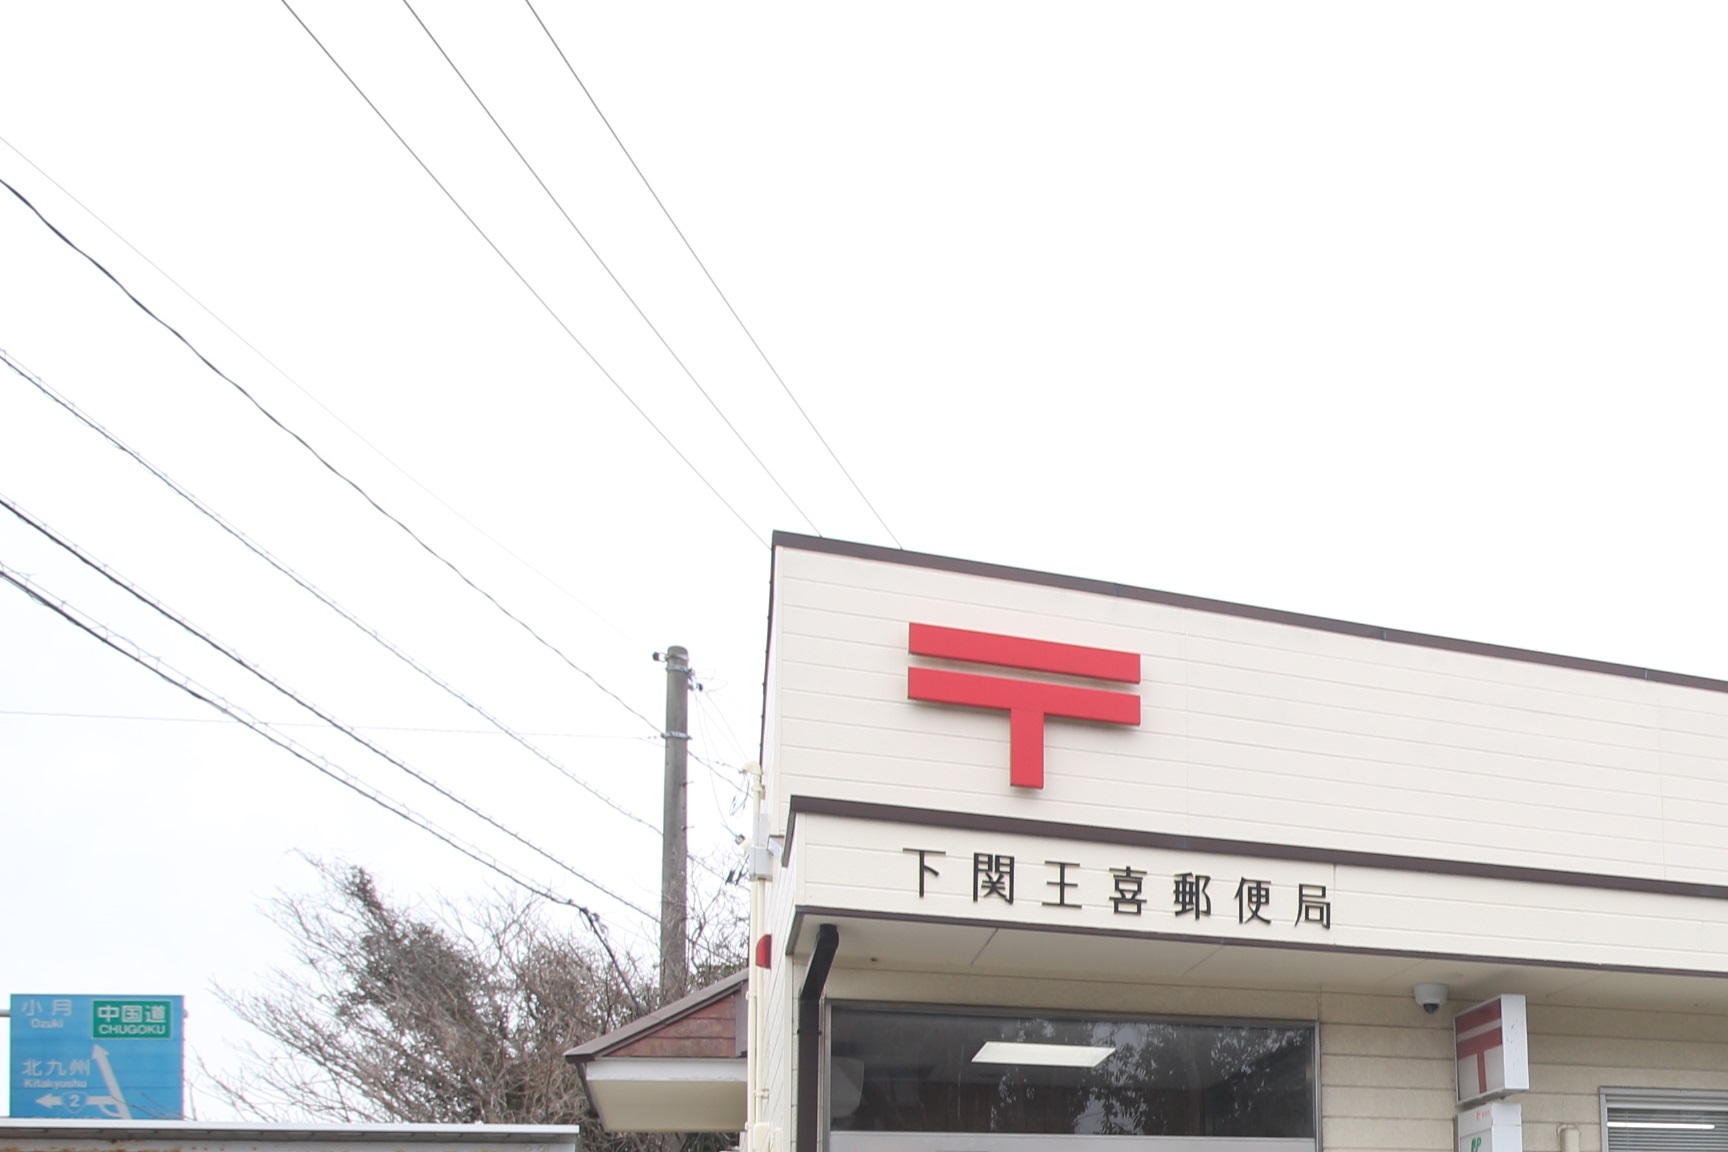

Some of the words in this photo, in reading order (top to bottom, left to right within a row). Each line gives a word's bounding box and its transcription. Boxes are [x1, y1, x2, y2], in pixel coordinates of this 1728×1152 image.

[902, 847, 1332, 930] 下関王喜郵便局
[21, 999, 72, 1017] 小月
[97, 1005, 167, 1023] 中国道
[31, 1018, 65, 1029] Ozuki
[98, 1024, 166, 1035] CHUGOKU
[21, 1058, 92, 1077] 北九州
[24, 1079, 88, 1090] Kitakyushu
[69, 1094, 80, 1107] 2
